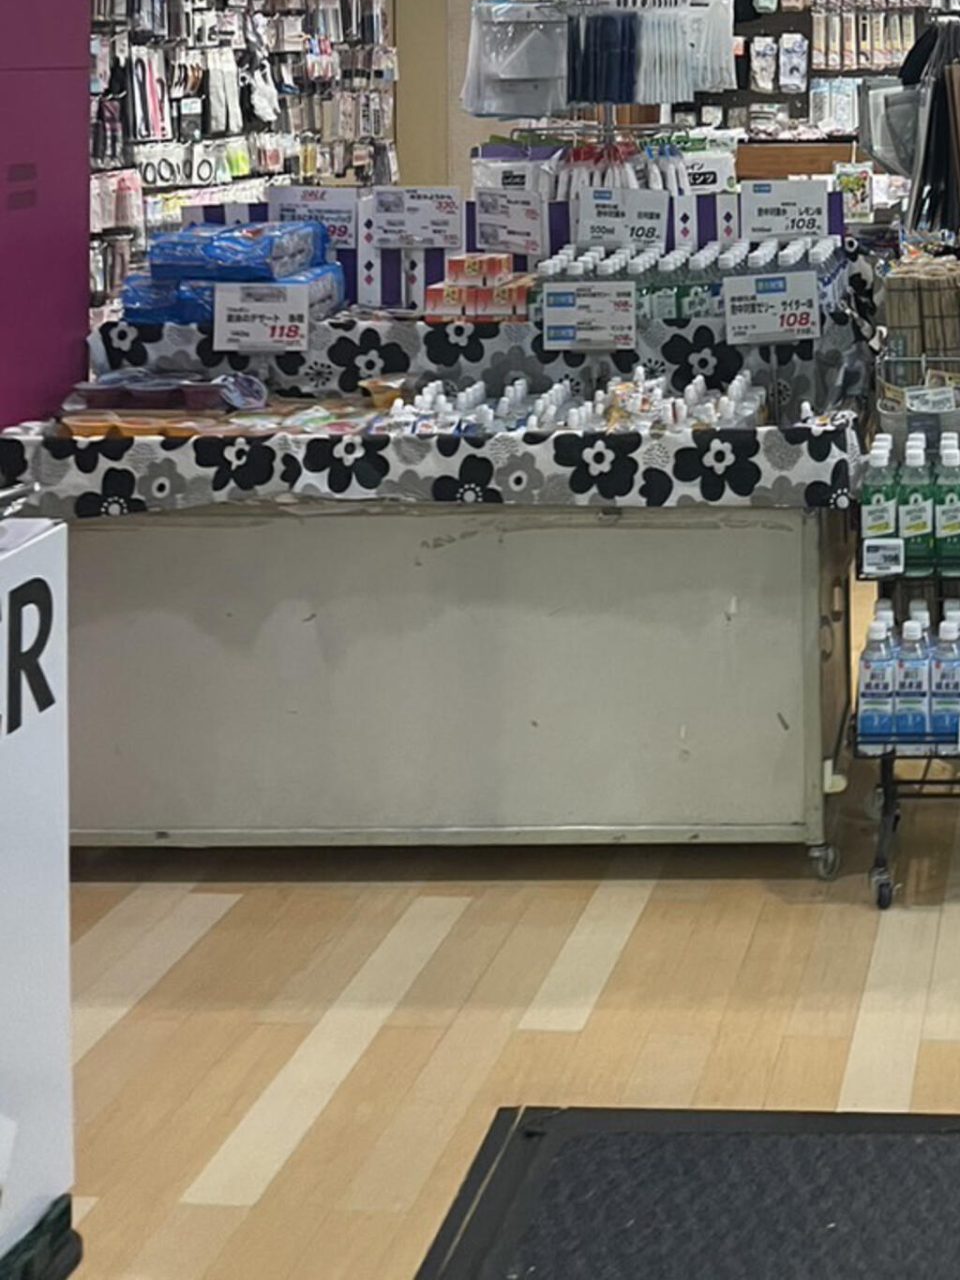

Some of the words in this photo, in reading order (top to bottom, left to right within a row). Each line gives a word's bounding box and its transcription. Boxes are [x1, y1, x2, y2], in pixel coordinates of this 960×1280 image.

[790, 218, 816, 230] 108
[630, 226, 656, 238] 108
[779, 312, 810, 328] 108
[269, 324, 300, 338] 118
